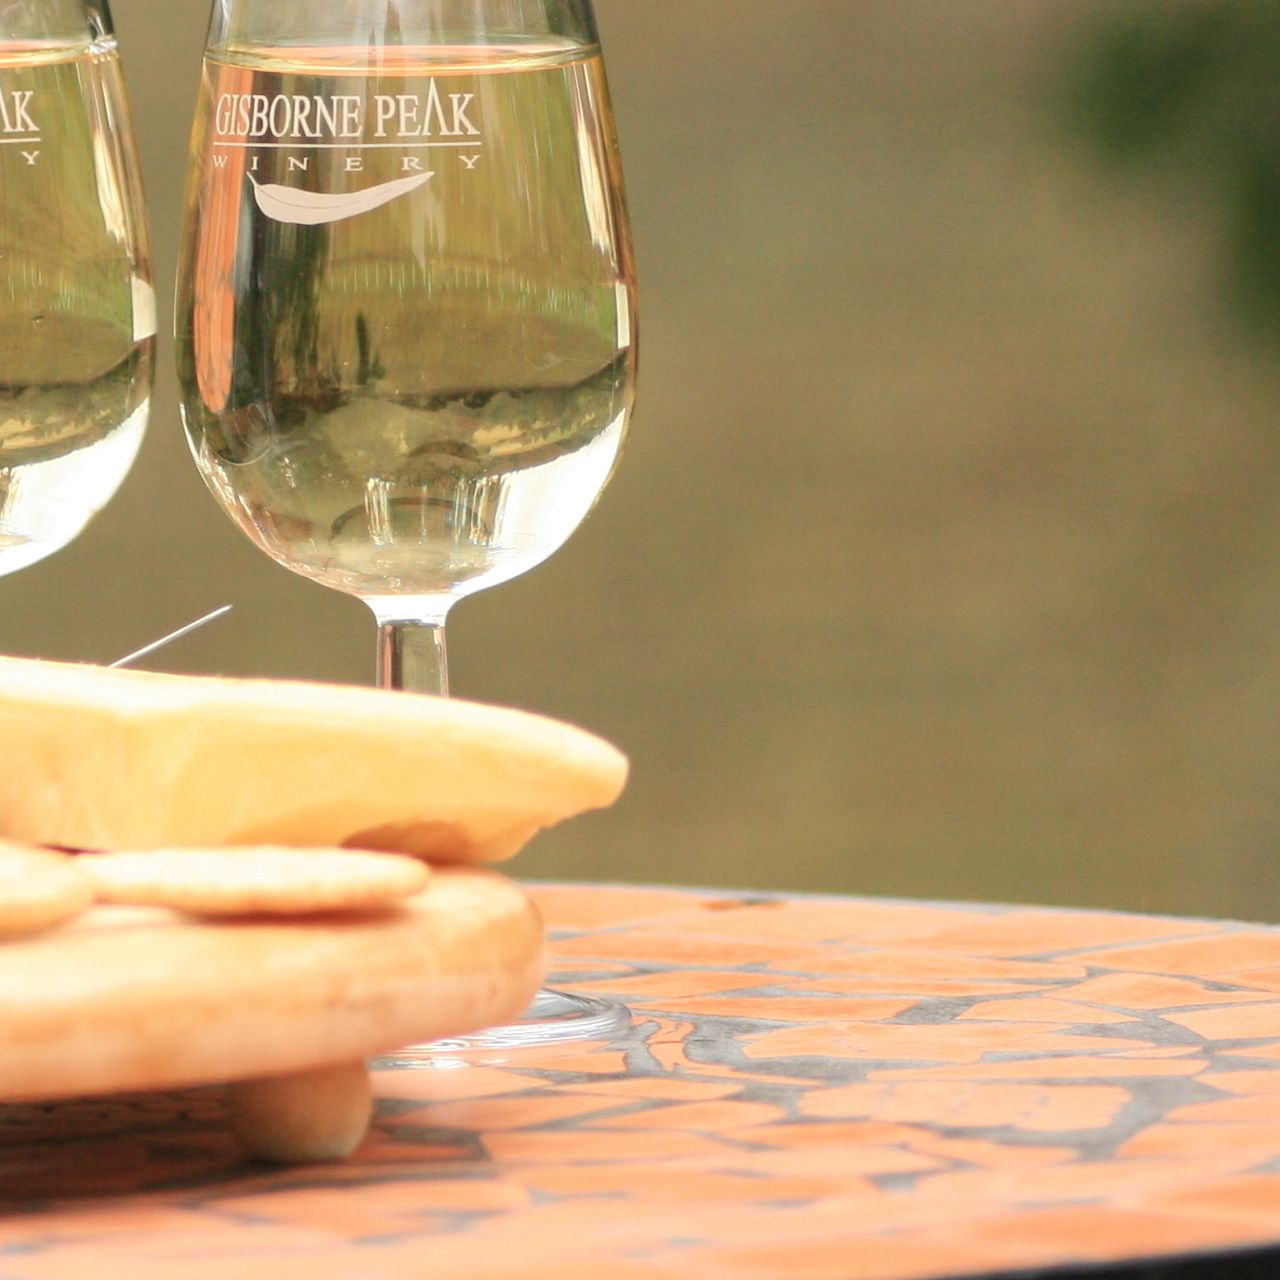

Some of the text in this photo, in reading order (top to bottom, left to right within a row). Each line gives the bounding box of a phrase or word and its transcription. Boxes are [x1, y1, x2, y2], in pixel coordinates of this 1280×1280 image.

[215, 77, 480, 137] GISBORNE PEAK
[212, 155, 481, 171] WINERY
